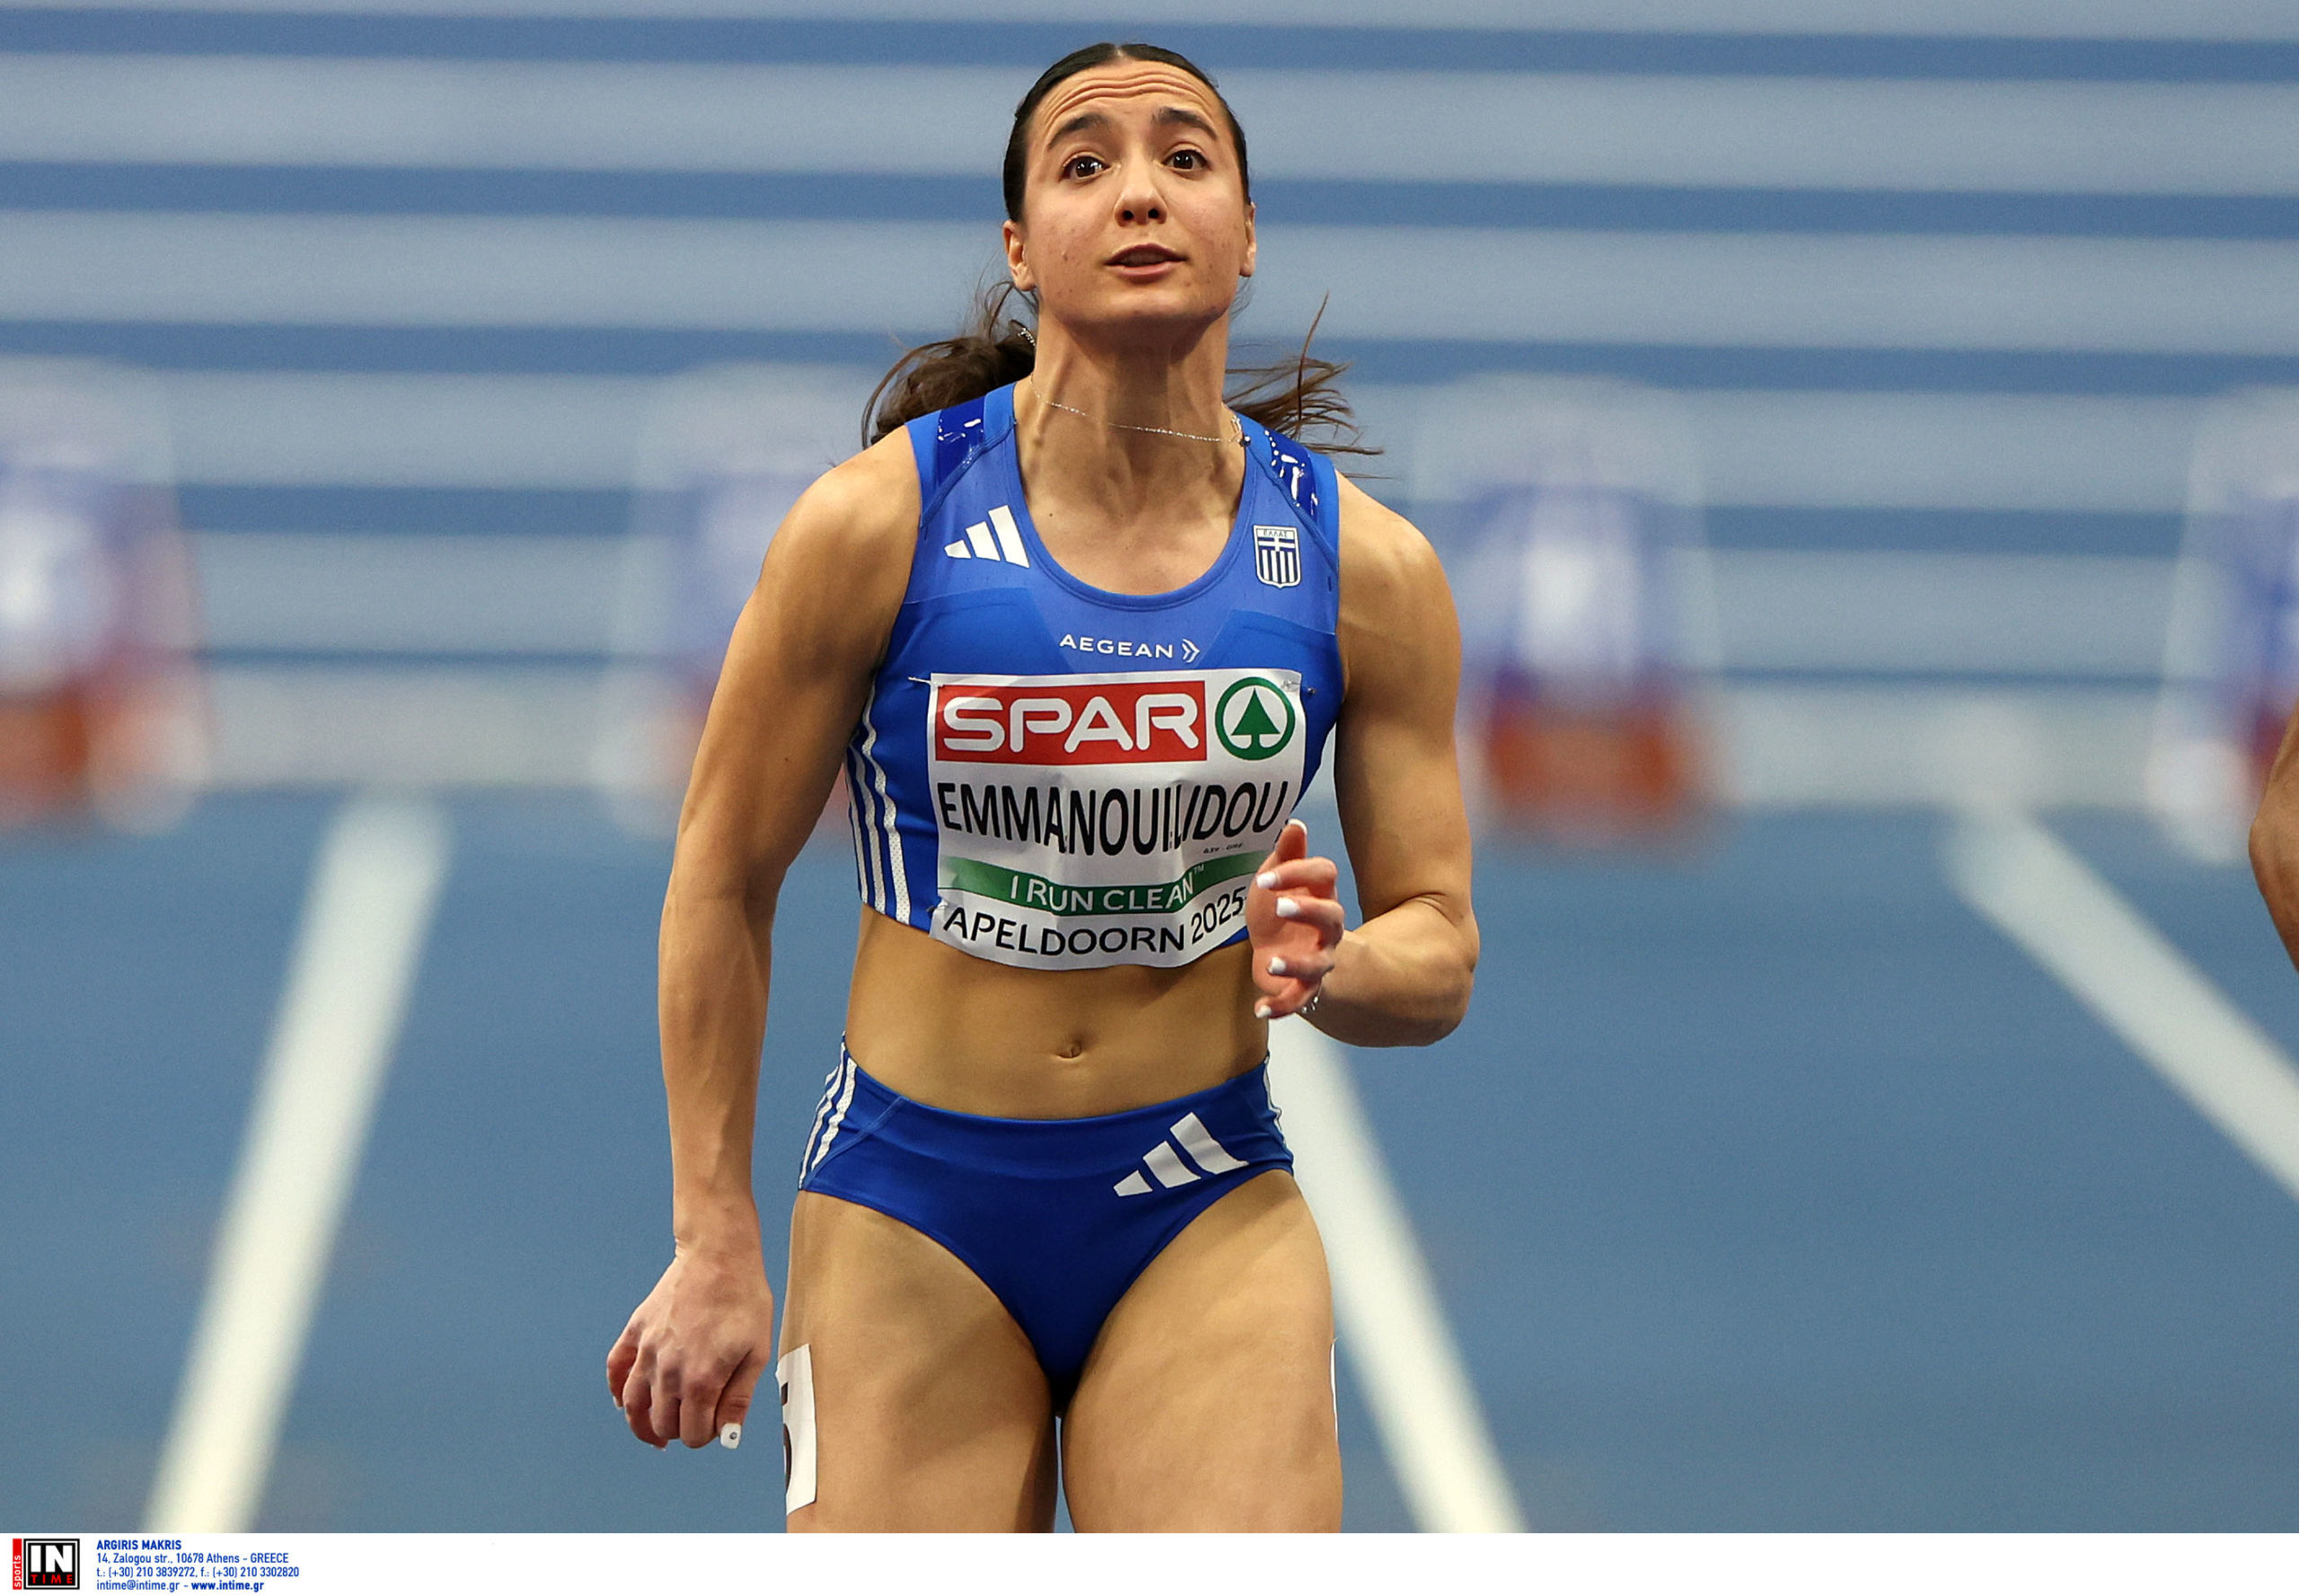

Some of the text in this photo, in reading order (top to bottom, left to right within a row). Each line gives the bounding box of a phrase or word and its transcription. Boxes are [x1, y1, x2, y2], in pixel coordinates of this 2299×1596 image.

[1059, 633, 1174, 659] AEGEAN
[943, 692, 1200, 754] SPAR
[1009, 874, 1019, 900] I
[1026, 877, 1094, 913] RUN
[943, 886, 1247, 957] APELDOORN 2025
